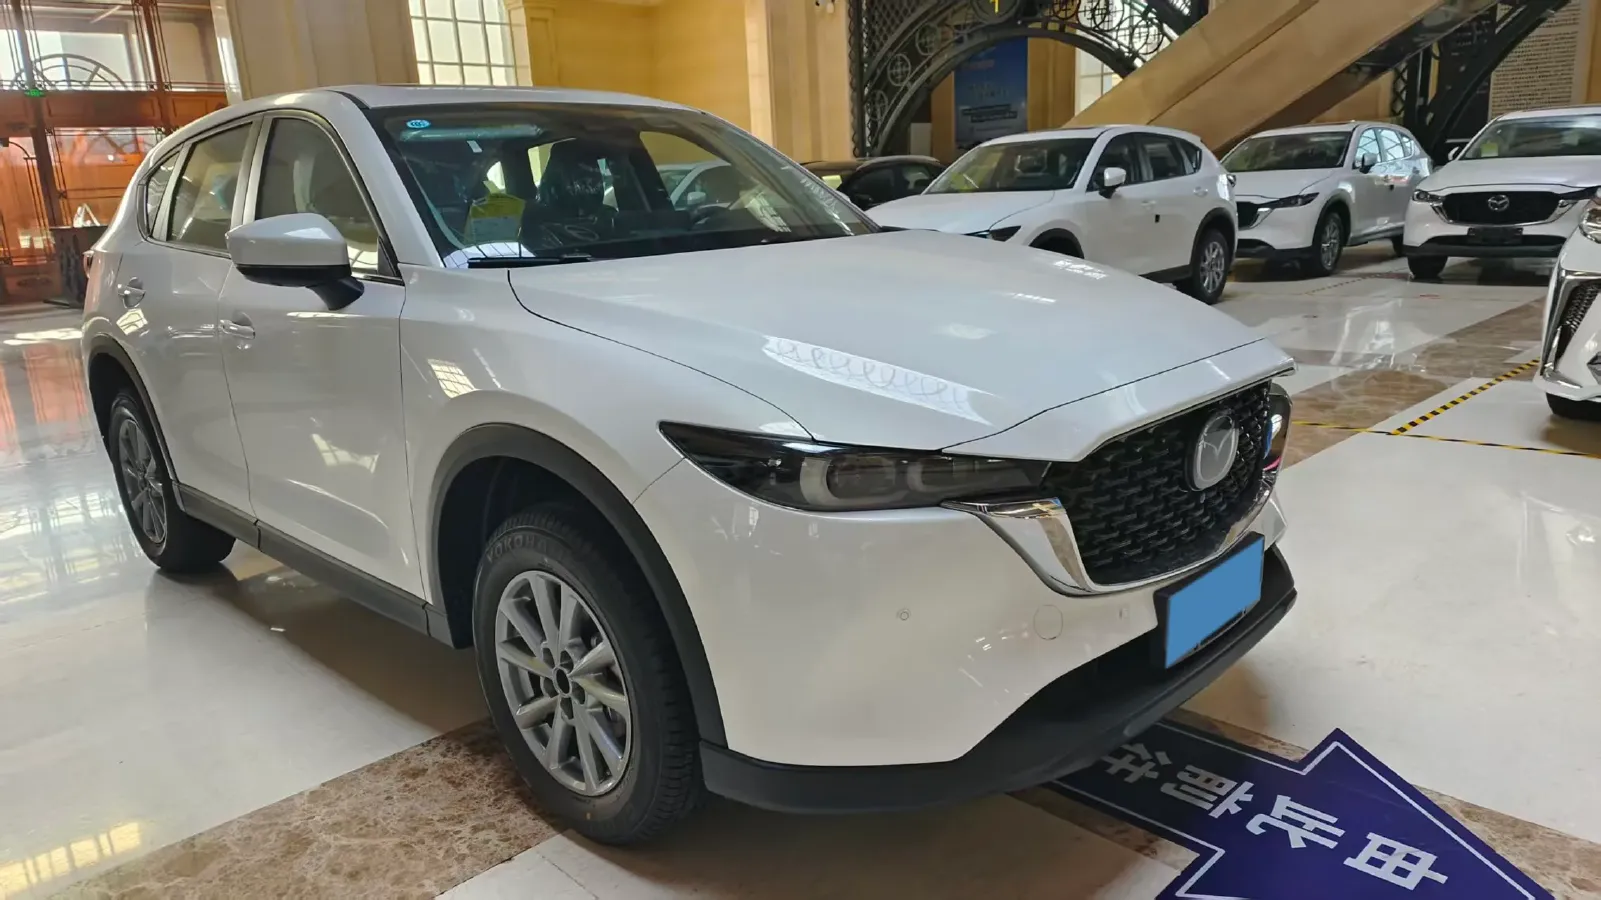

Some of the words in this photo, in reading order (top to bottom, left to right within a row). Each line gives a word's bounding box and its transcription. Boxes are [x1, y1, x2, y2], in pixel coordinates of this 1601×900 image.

[485, 534, 564, 563] YOKOHA
[1101, 743, 1449, 891] 由此前往
